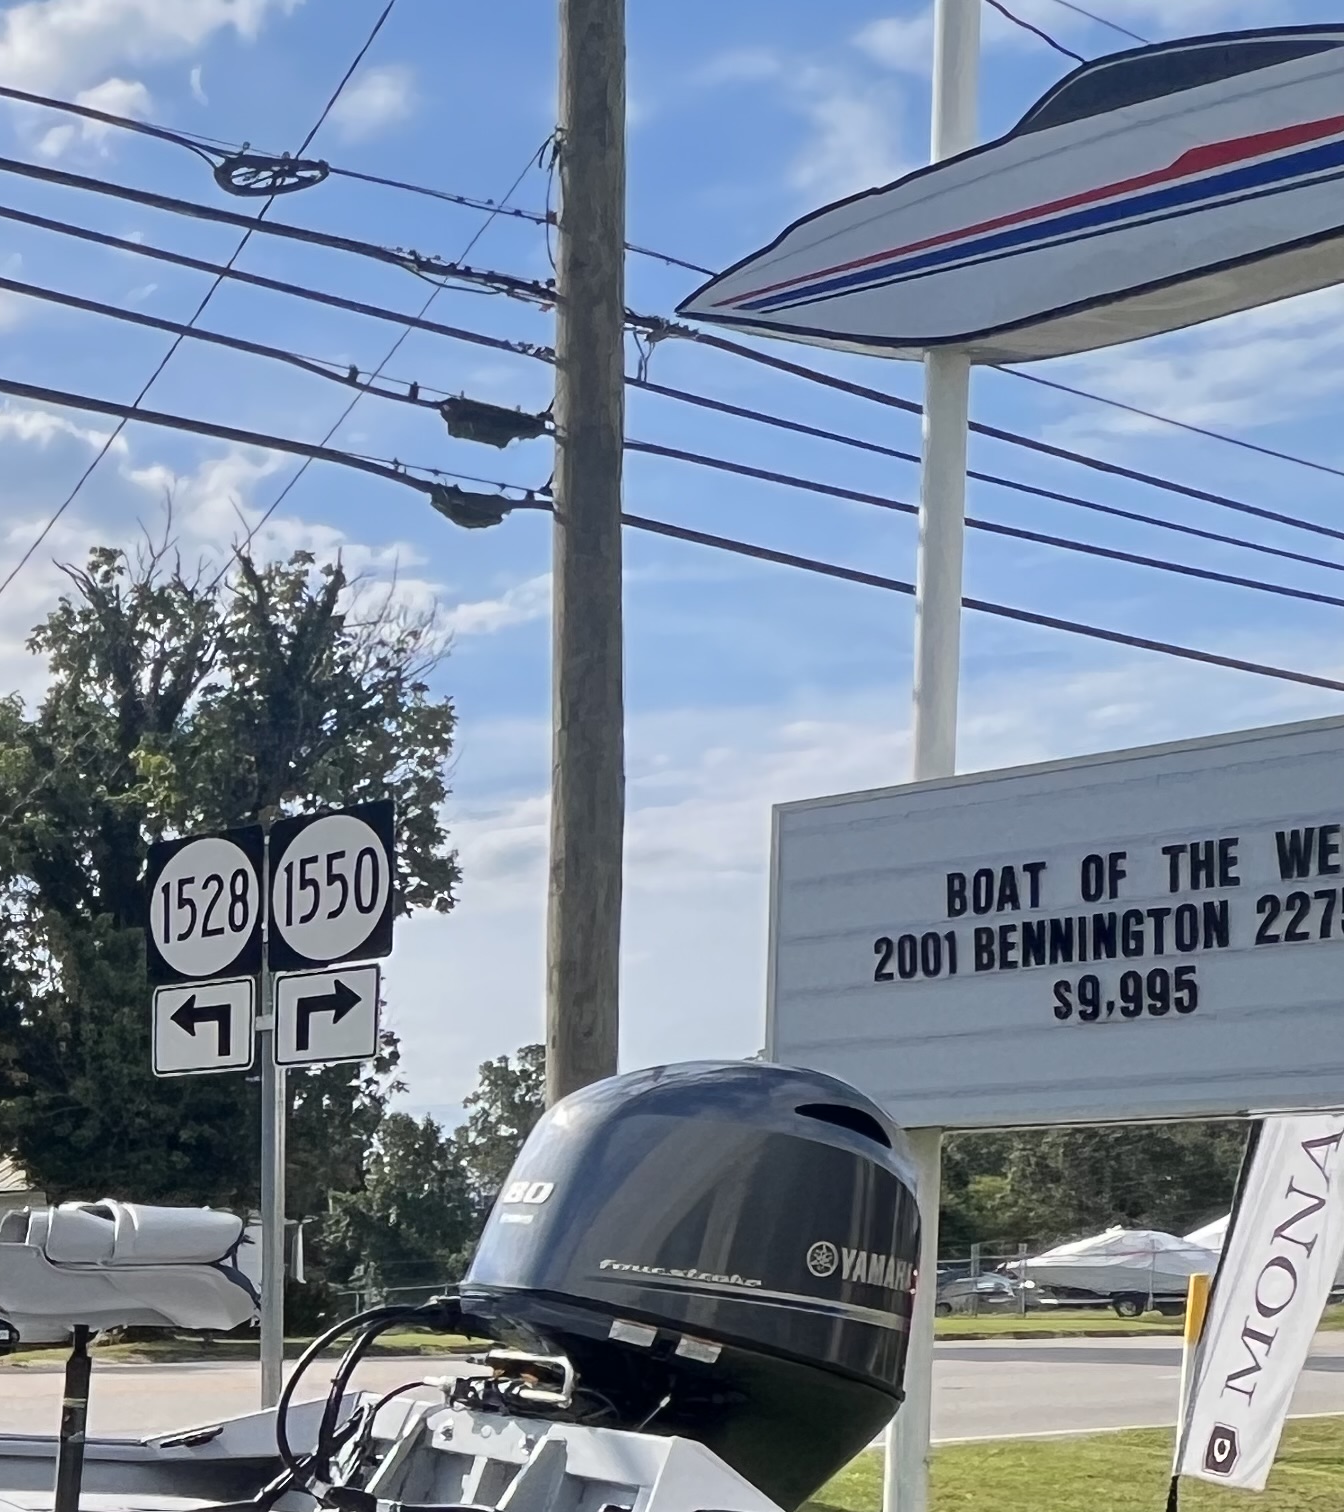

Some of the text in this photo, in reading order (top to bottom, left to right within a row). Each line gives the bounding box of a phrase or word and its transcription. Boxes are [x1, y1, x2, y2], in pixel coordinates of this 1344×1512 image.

[161, 868, 249, 944] 1528
[284, 846, 380, 927] 1550
[946, 823, 1342, 919] BOAT OF THE WE
[874, 886, 1344, 982] 2001 BENNINGTON 227
[1053, 965, 1200, 1023] $9,995
[1220, 1128, 1344, 1407] MONA
